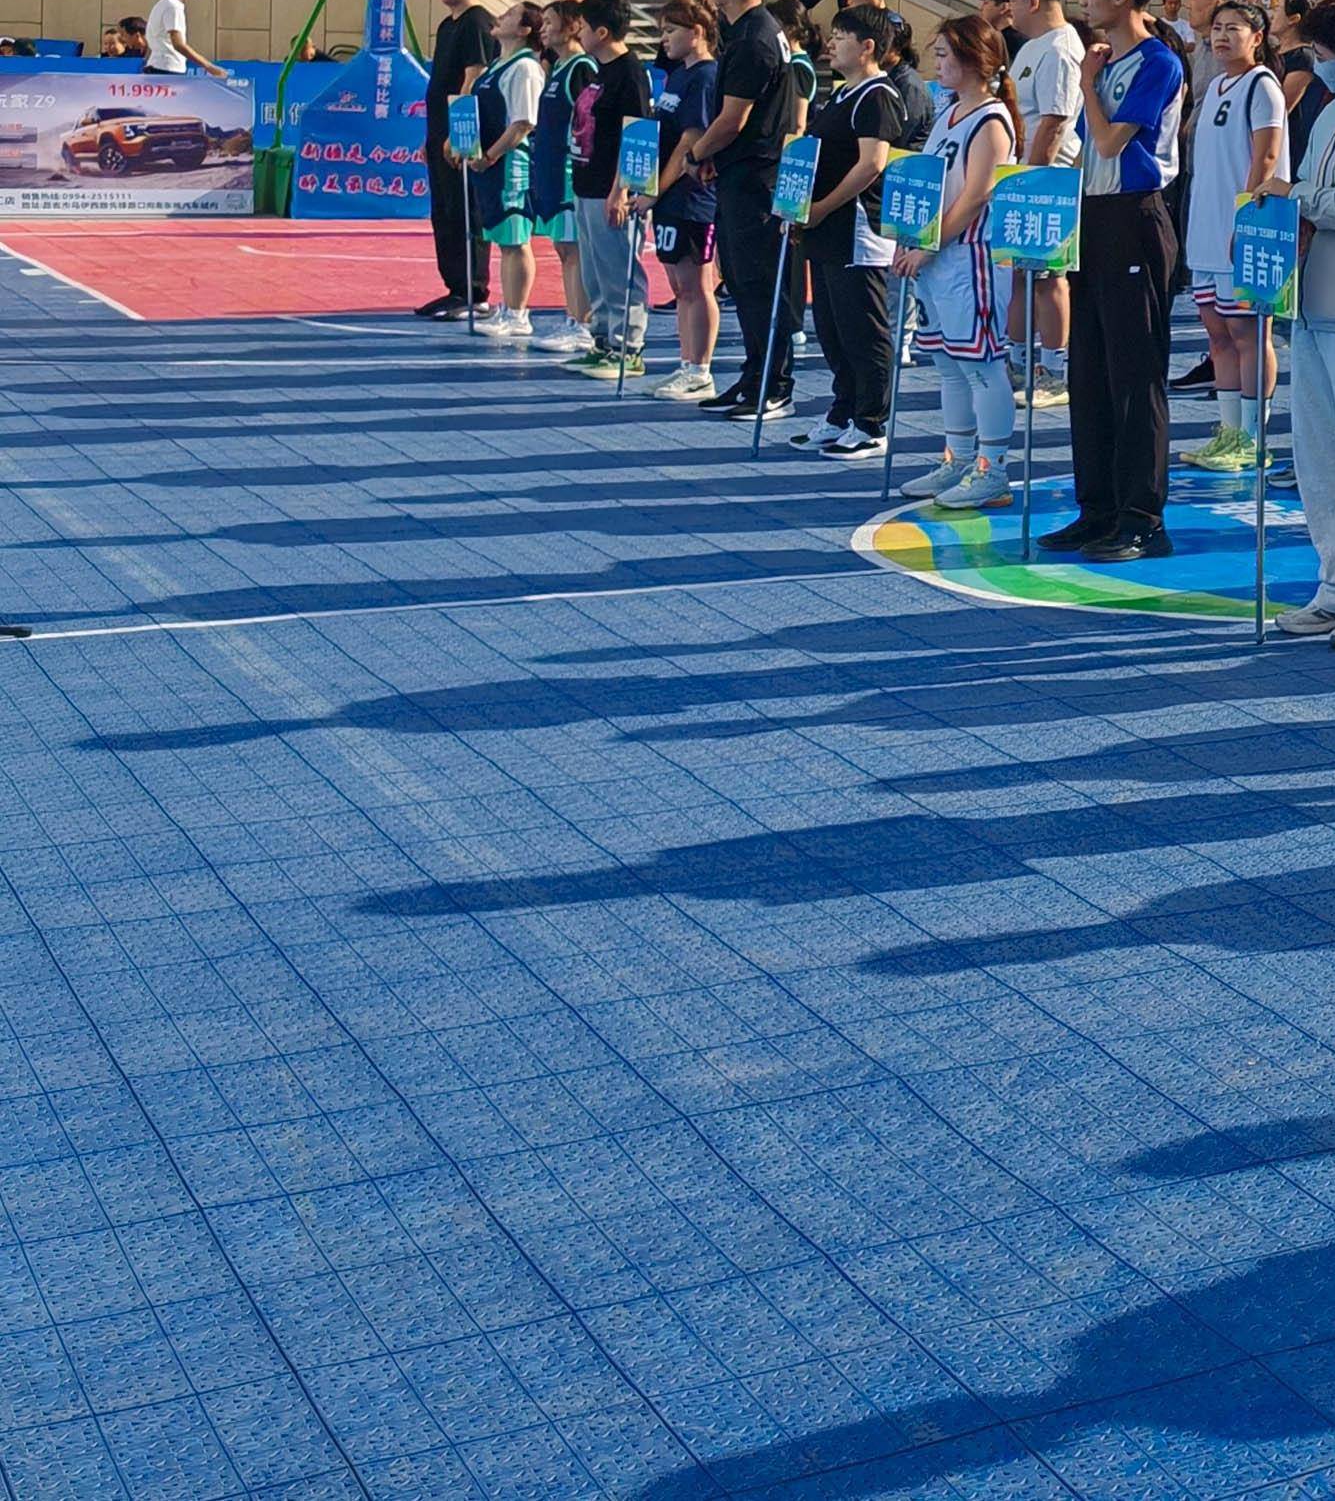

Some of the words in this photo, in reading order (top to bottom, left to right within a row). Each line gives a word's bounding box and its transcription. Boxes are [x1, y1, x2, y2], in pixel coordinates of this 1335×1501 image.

[1213, 100, 1232, 127] 6
[889, 190, 930, 227] 阜康市
[1004, 210, 1062, 248] 裁判员
[1243, 243, 1285, 290] 昌吉市
